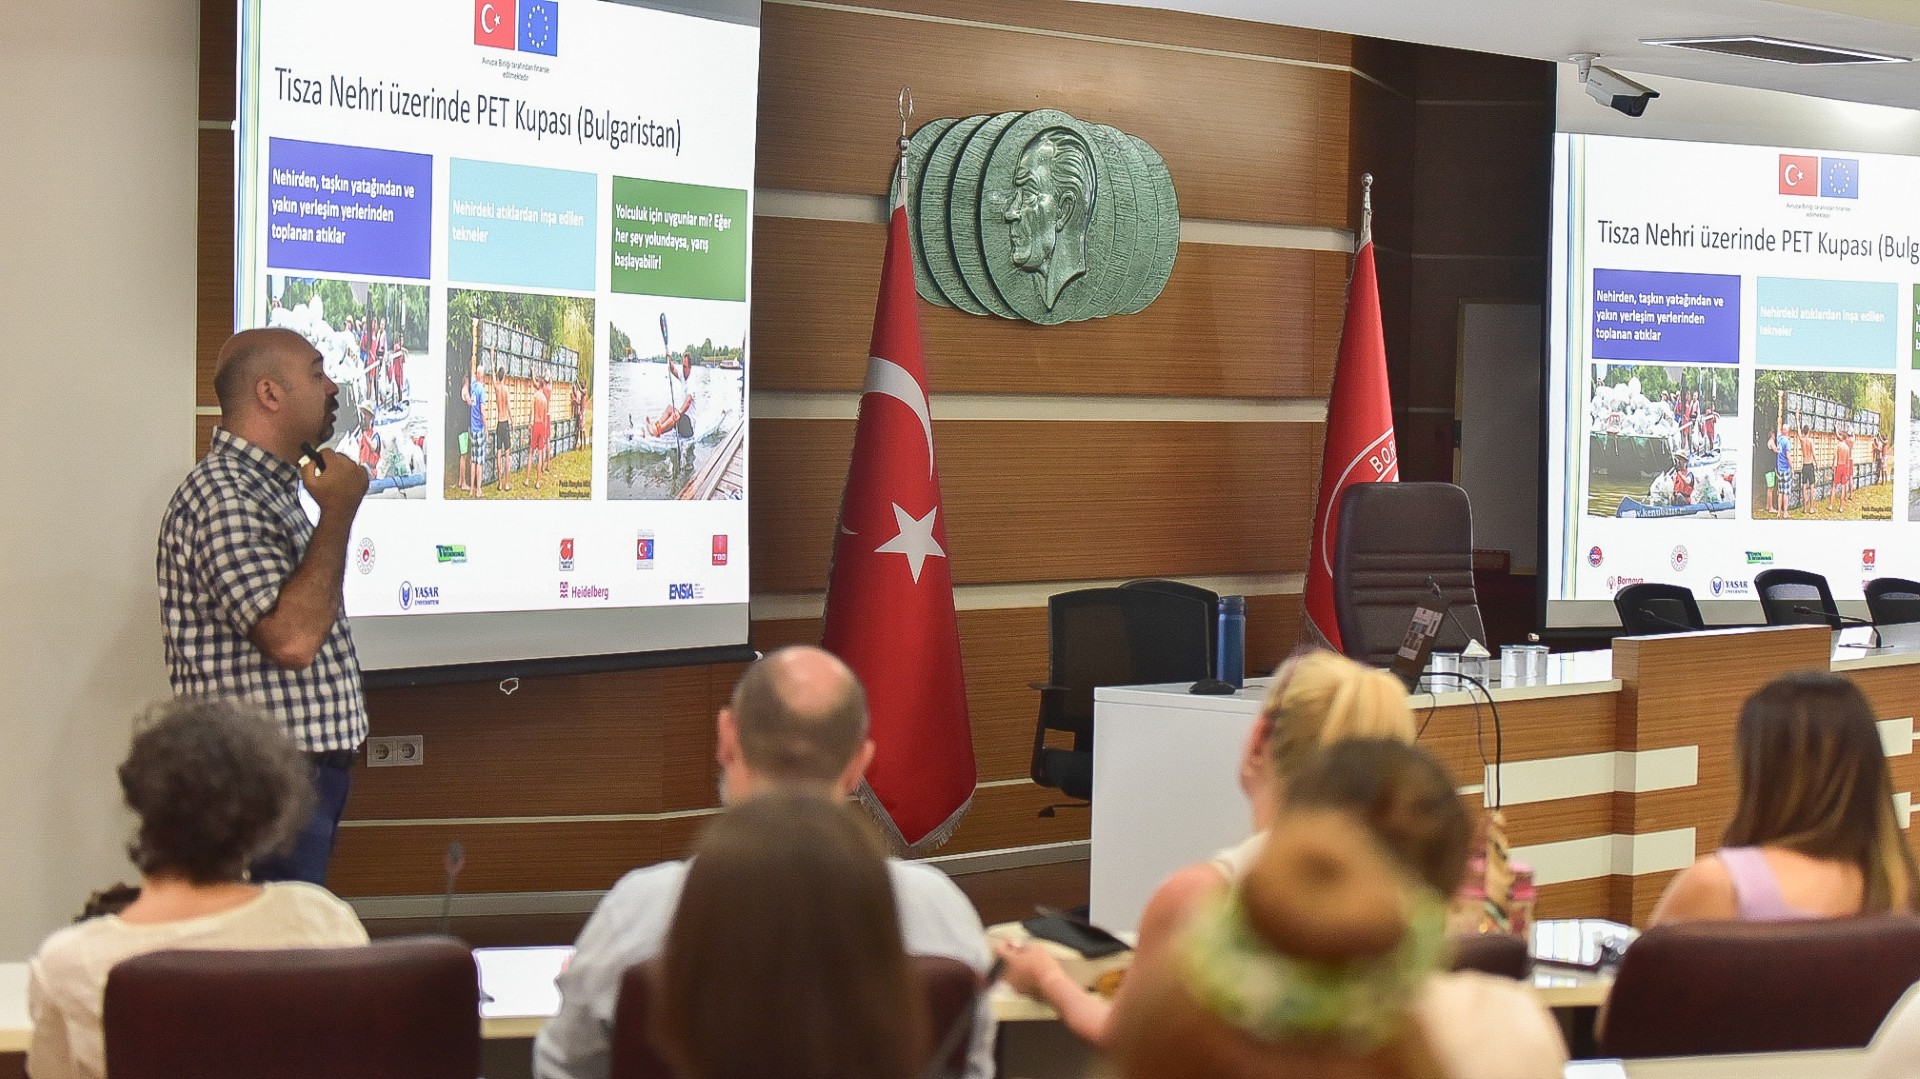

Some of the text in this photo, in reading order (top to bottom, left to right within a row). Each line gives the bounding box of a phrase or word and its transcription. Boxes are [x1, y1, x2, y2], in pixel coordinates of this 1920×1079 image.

[275, 66, 681, 156] Tisza Nehri üzerinde PET Kupası (Bulgaristan)
[272, 168, 415, 198] Nehirden, taşkın yatağından ve
[272, 196, 394, 223] yakın yerleşim yerlerinden
[452, 199, 495, 219] Nehirdeki
[615, 203, 648, 221] Yolculuk
[649, 206, 663, 226] için
[664, 211, 697, 228] uygunlar
[714, 212, 732, 232] Eğer
[271, 223, 346, 245] toplanan atıklar
[452, 226, 488, 243] tekneler
[615, 227, 629, 243] her
[630, 233, 644, 248] şey
[645, 230, 690, 252] yolundaysa,
[1598, 220, 1639, 245] Tisza
[1646, 222, 1694, 248] Nehri
[1701, 225, 1776, 252] üzerinde
[1782, 230, 1813, 254] PET
[1818, 231, 1872, 261] Kupası
[614, 250, 662, 271] başlayabilir!
[1596, 290, 1724, 308] Nehirden, taşkın yatağından ve
[1596, 308, 1705, 326] yakın yerleşim yerlerinden
[1596, 327, 1662, 342] toplanan atıklar
[571, 585, 609, 600] Heidelberg
